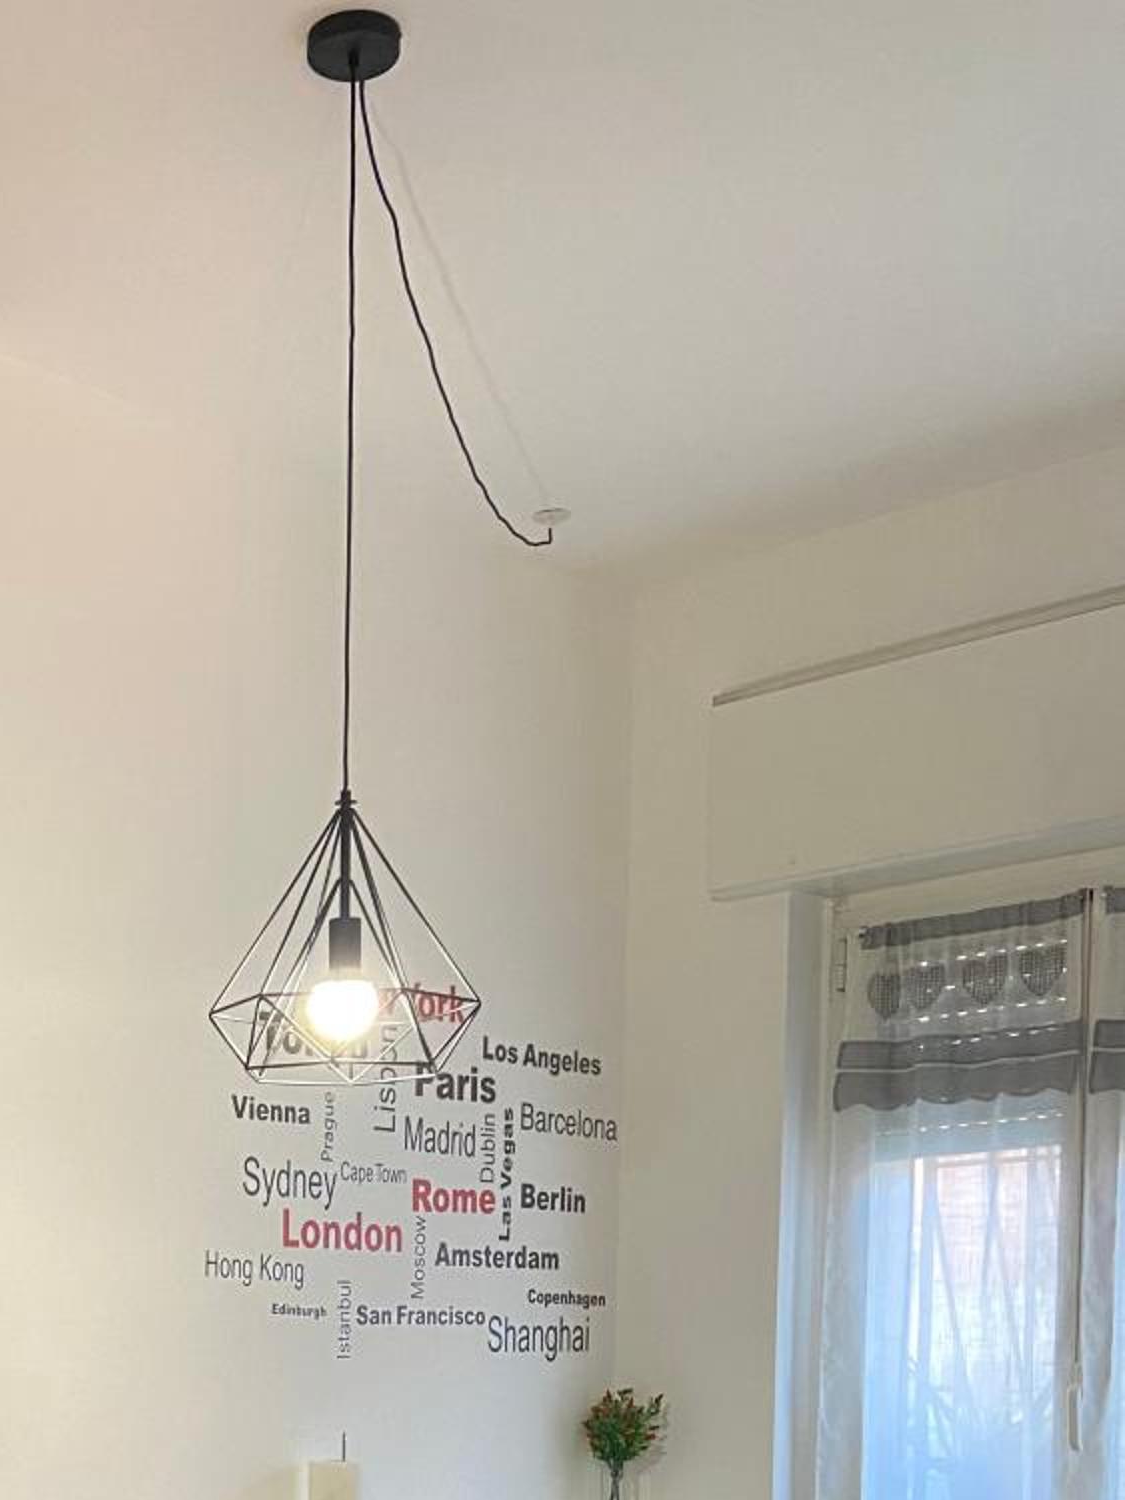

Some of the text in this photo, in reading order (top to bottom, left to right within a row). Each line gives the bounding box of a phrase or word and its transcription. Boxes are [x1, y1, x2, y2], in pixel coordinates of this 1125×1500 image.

[482, 1035, 602, 1076] Los Angeles
[415, 1064, 496, 1103] Paris
[231, 1094, 311, 1124] Vienna
[321, 1091, 337, 1163] Prague
[520, 1102, 618, 1142] Barcelona
[404, 1115, 475, 1158] Madrid
[480, 1113, 495, 1184] Dublin
[242, 1156, 337, 1211] Sydney
[340, 1161, 407, 1184] Cape Town
[499, 1107, 516, 1242] Las Vegas
[412, 1178, 496, 1215] Rome
[520, 1183, 586, 1213] Berlin
[282, 1208, 403, 1252] London
[205, 1250, 305, 1290] Hong Kong
[411, 1215, 426, 1300] Moscow
[434, 1242, 560, 1270] Amsterdam
[271, 1303, 328, 1320] Edinburgh
[337, 1279, 352, 1359] Istanbul
[356, 1304, 485, 1326] San Francisco
[527, 1289, 606, 1310] Copenhagen
[487, 1315, 590, 1362] Shanghai
